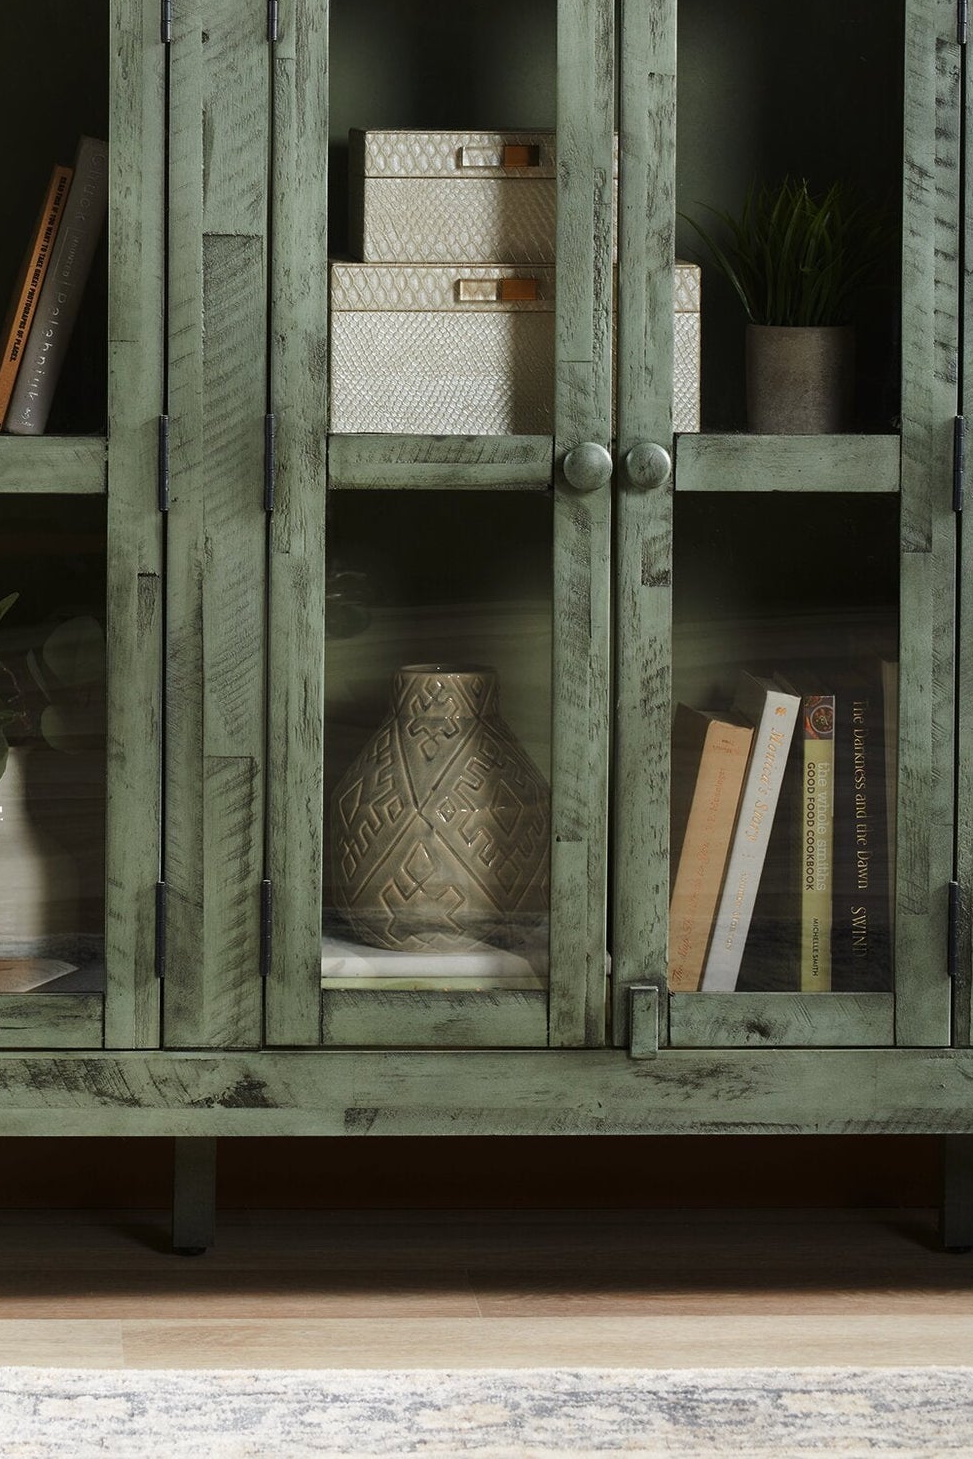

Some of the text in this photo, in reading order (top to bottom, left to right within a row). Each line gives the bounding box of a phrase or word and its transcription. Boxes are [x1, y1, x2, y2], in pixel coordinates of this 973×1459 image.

[43, 226, 53, 243] WANT
[36, 253, 46, 268] TAKE
[40, 244, 49, 253] TO
[31, 268, 42, 288] GREAT
[852, 700, 868, 724] The
[853, 729, 867, 790] Darkness
[855, 793, 869, 819] and
[806, 762, 816, 891] GOOD FOOD COOKBOOK
[816, 762, 830, 891] the whole smiths
[856, 823, 870, 846] the
[856, 850, 870, 889] Dawn
[812, 918, 820, 952] MICHELLE
